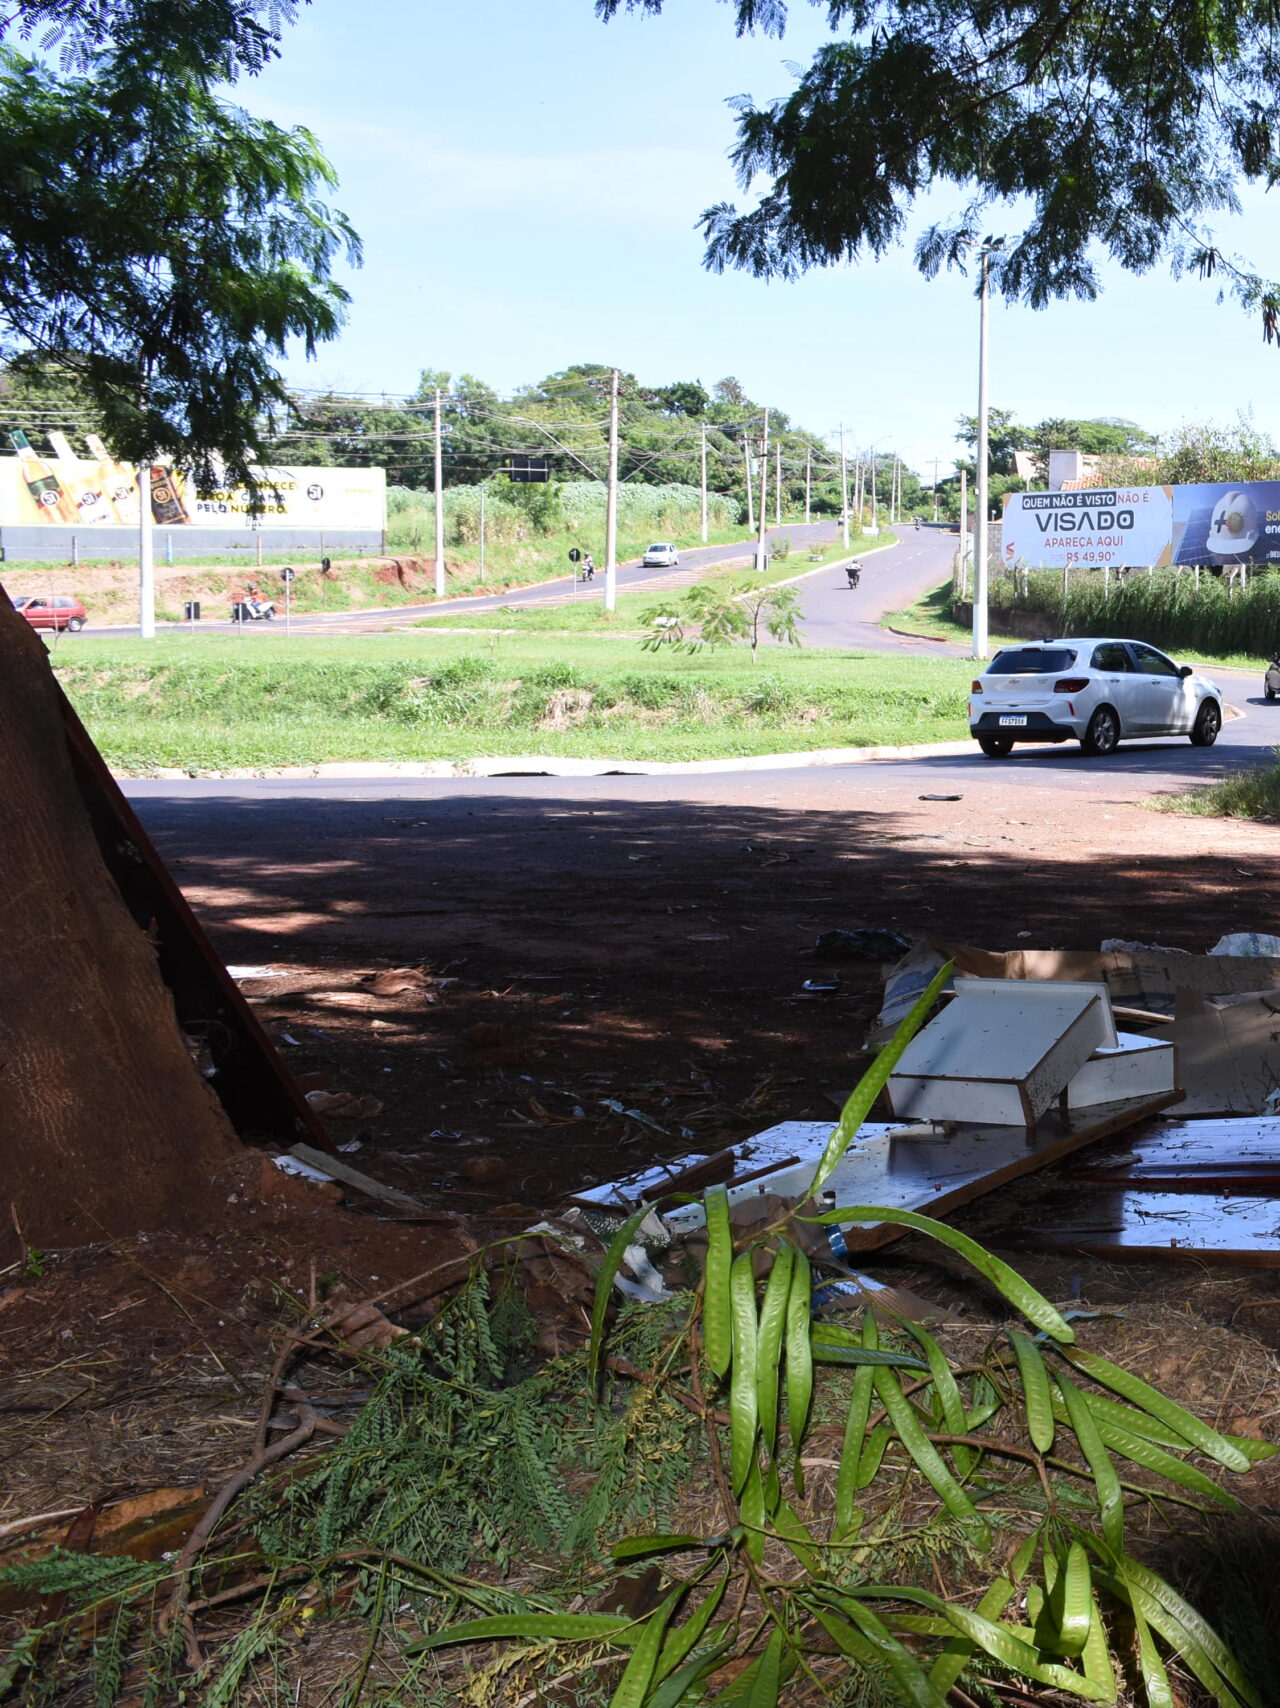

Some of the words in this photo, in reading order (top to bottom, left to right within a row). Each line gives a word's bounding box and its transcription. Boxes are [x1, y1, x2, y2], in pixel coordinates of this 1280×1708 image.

[308, 485, 323, 500] 51
[1023, 498, 1050, 508] QUEM
[1053, 494, 1074, 507] NÃO
[1077, 494, 1083, 506] É
[1085, 494, 1115, 505] VISTO
[1117, 492, 1139, 504] NÃO
[1143, 490, 1149, 503] É
[1035, 510, 1134, 532] VISADO
[1044, 536, 1093, 549] APAREÇA
[1097, 535, 1123, 547] AQUI
[1066, 551, 1079, 563] R$
